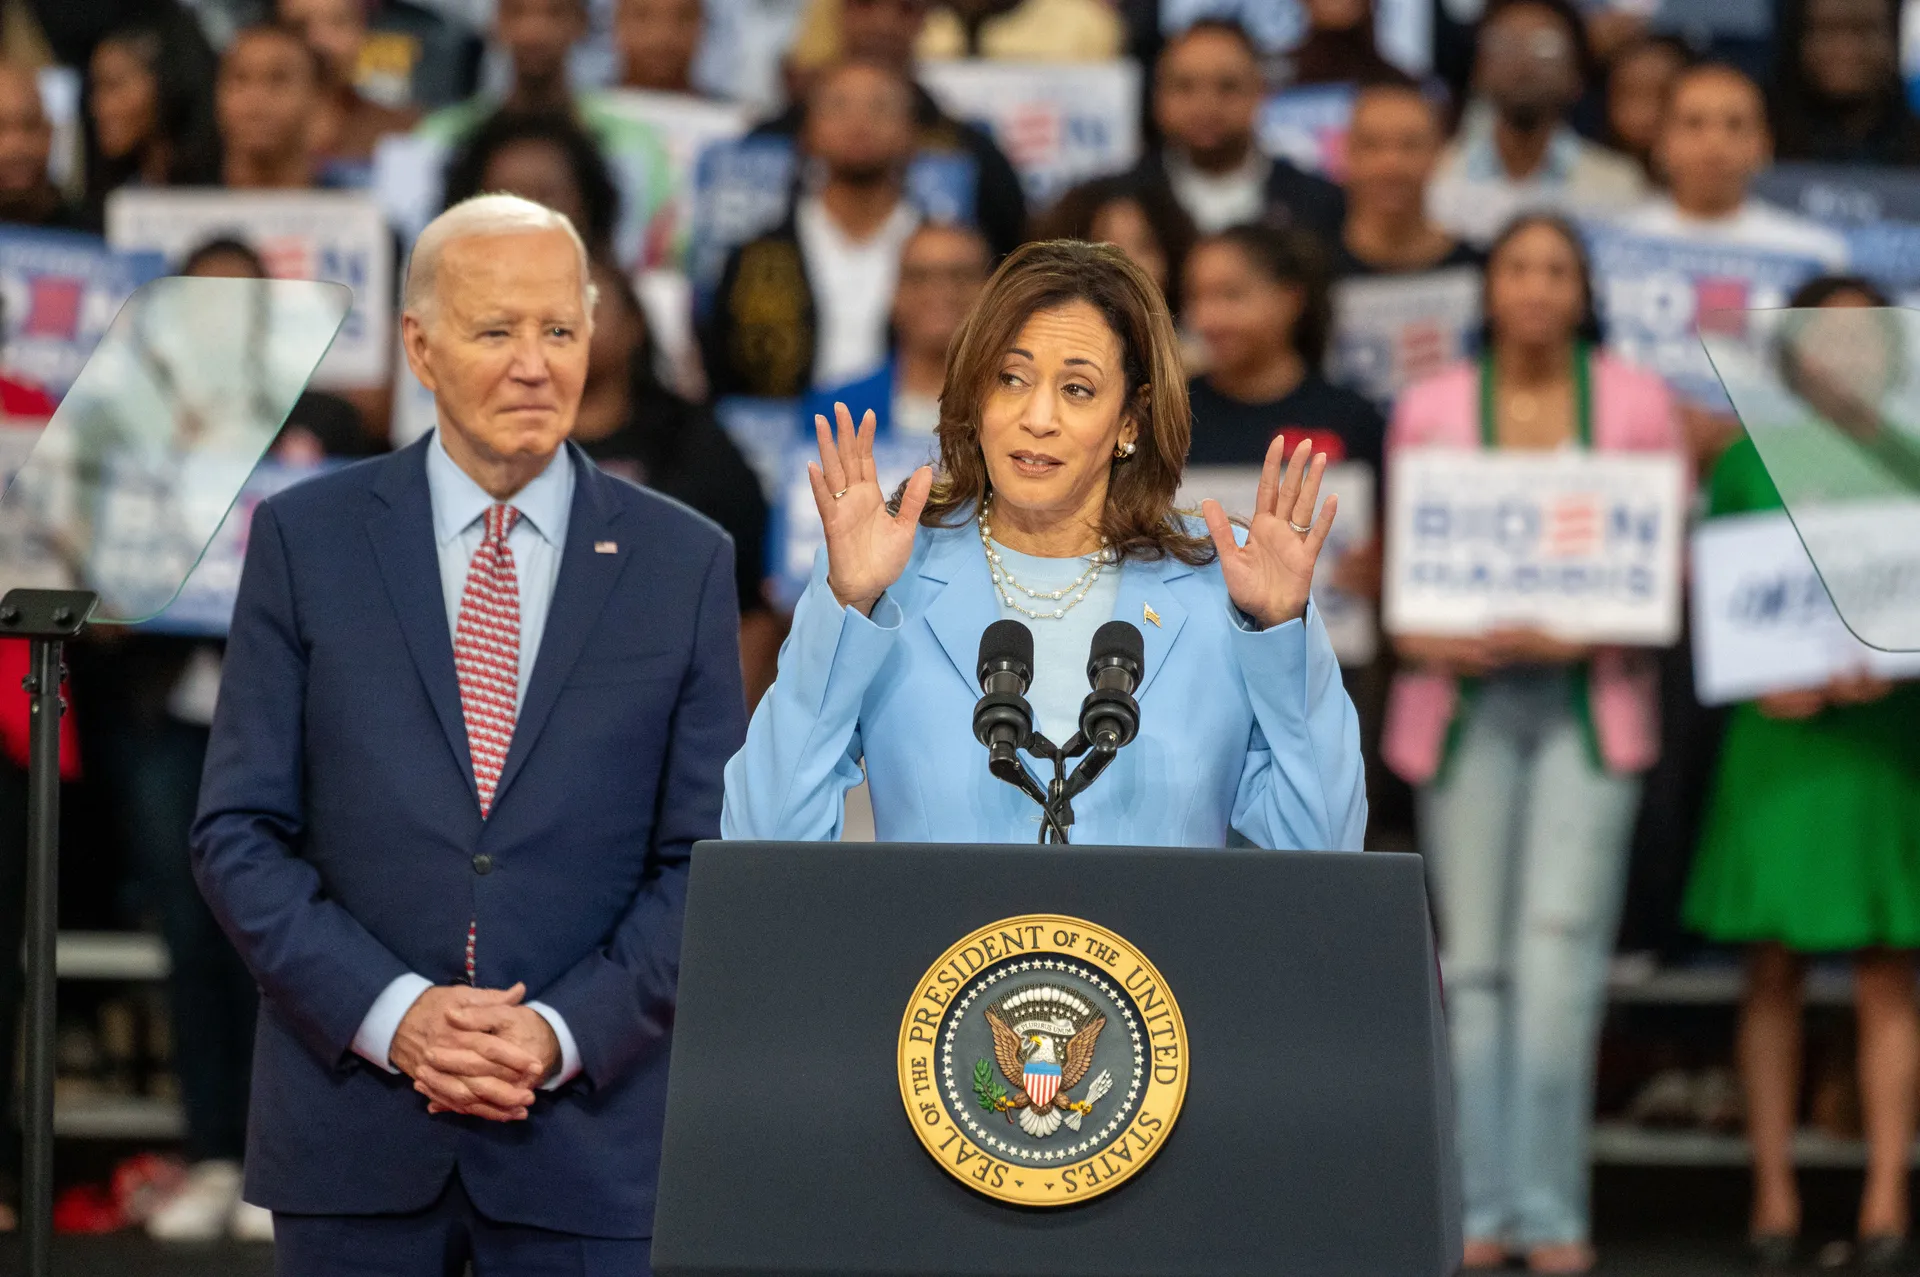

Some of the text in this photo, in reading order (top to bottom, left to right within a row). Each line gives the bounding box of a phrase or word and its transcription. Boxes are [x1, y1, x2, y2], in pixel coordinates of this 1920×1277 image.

[909, 925, 1179, 1194] SEAL OF THE PRESIDENT OF THE UNITED STATES
